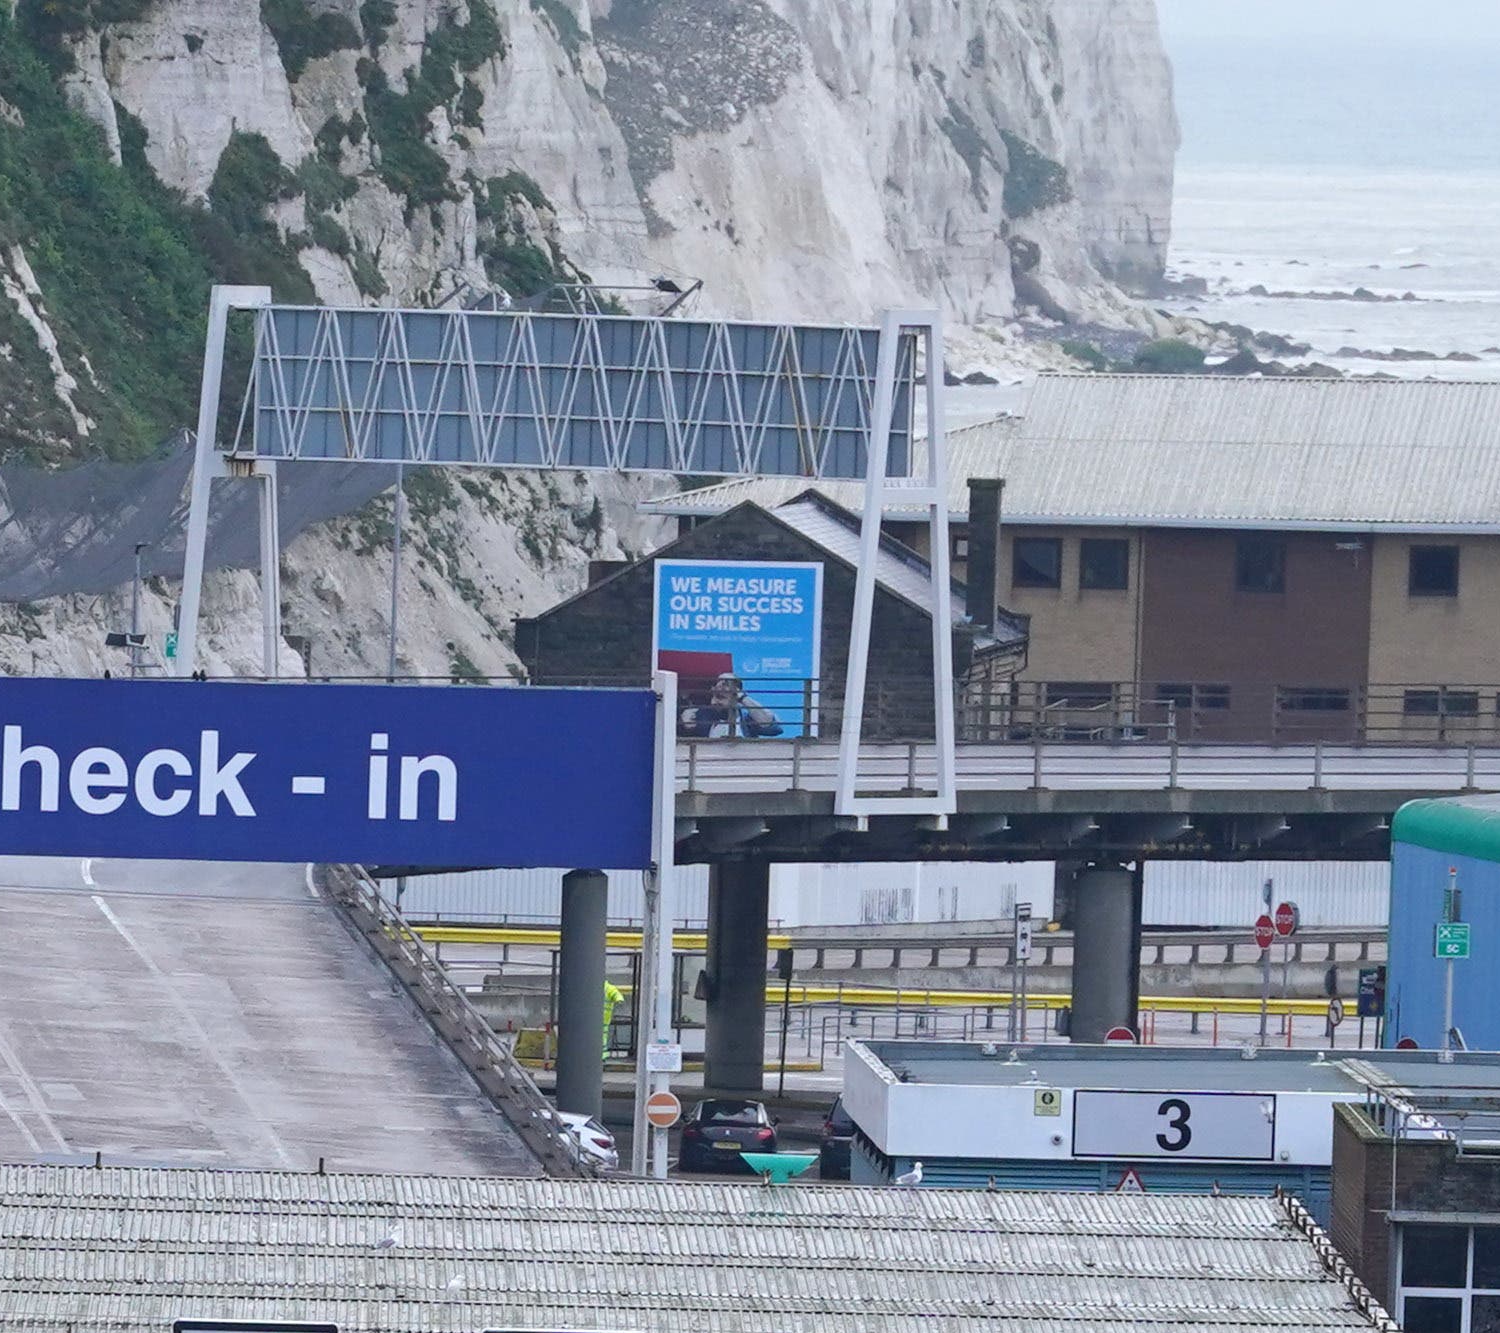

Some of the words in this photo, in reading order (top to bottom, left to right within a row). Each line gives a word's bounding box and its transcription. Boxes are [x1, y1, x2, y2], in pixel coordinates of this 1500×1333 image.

[671, 576, 701, 594] WE
[706, 577, 796, 595] MEASURE
[671, 595, 713, 612] OUR
[717, 597, 803, 615] SUCCESS
[670, 614, 690, 631] IN
[694, 615, 761, 632] SMILES
[365, 732, 457, 821] in
[1155, 1099, 1193, 1151] 3
